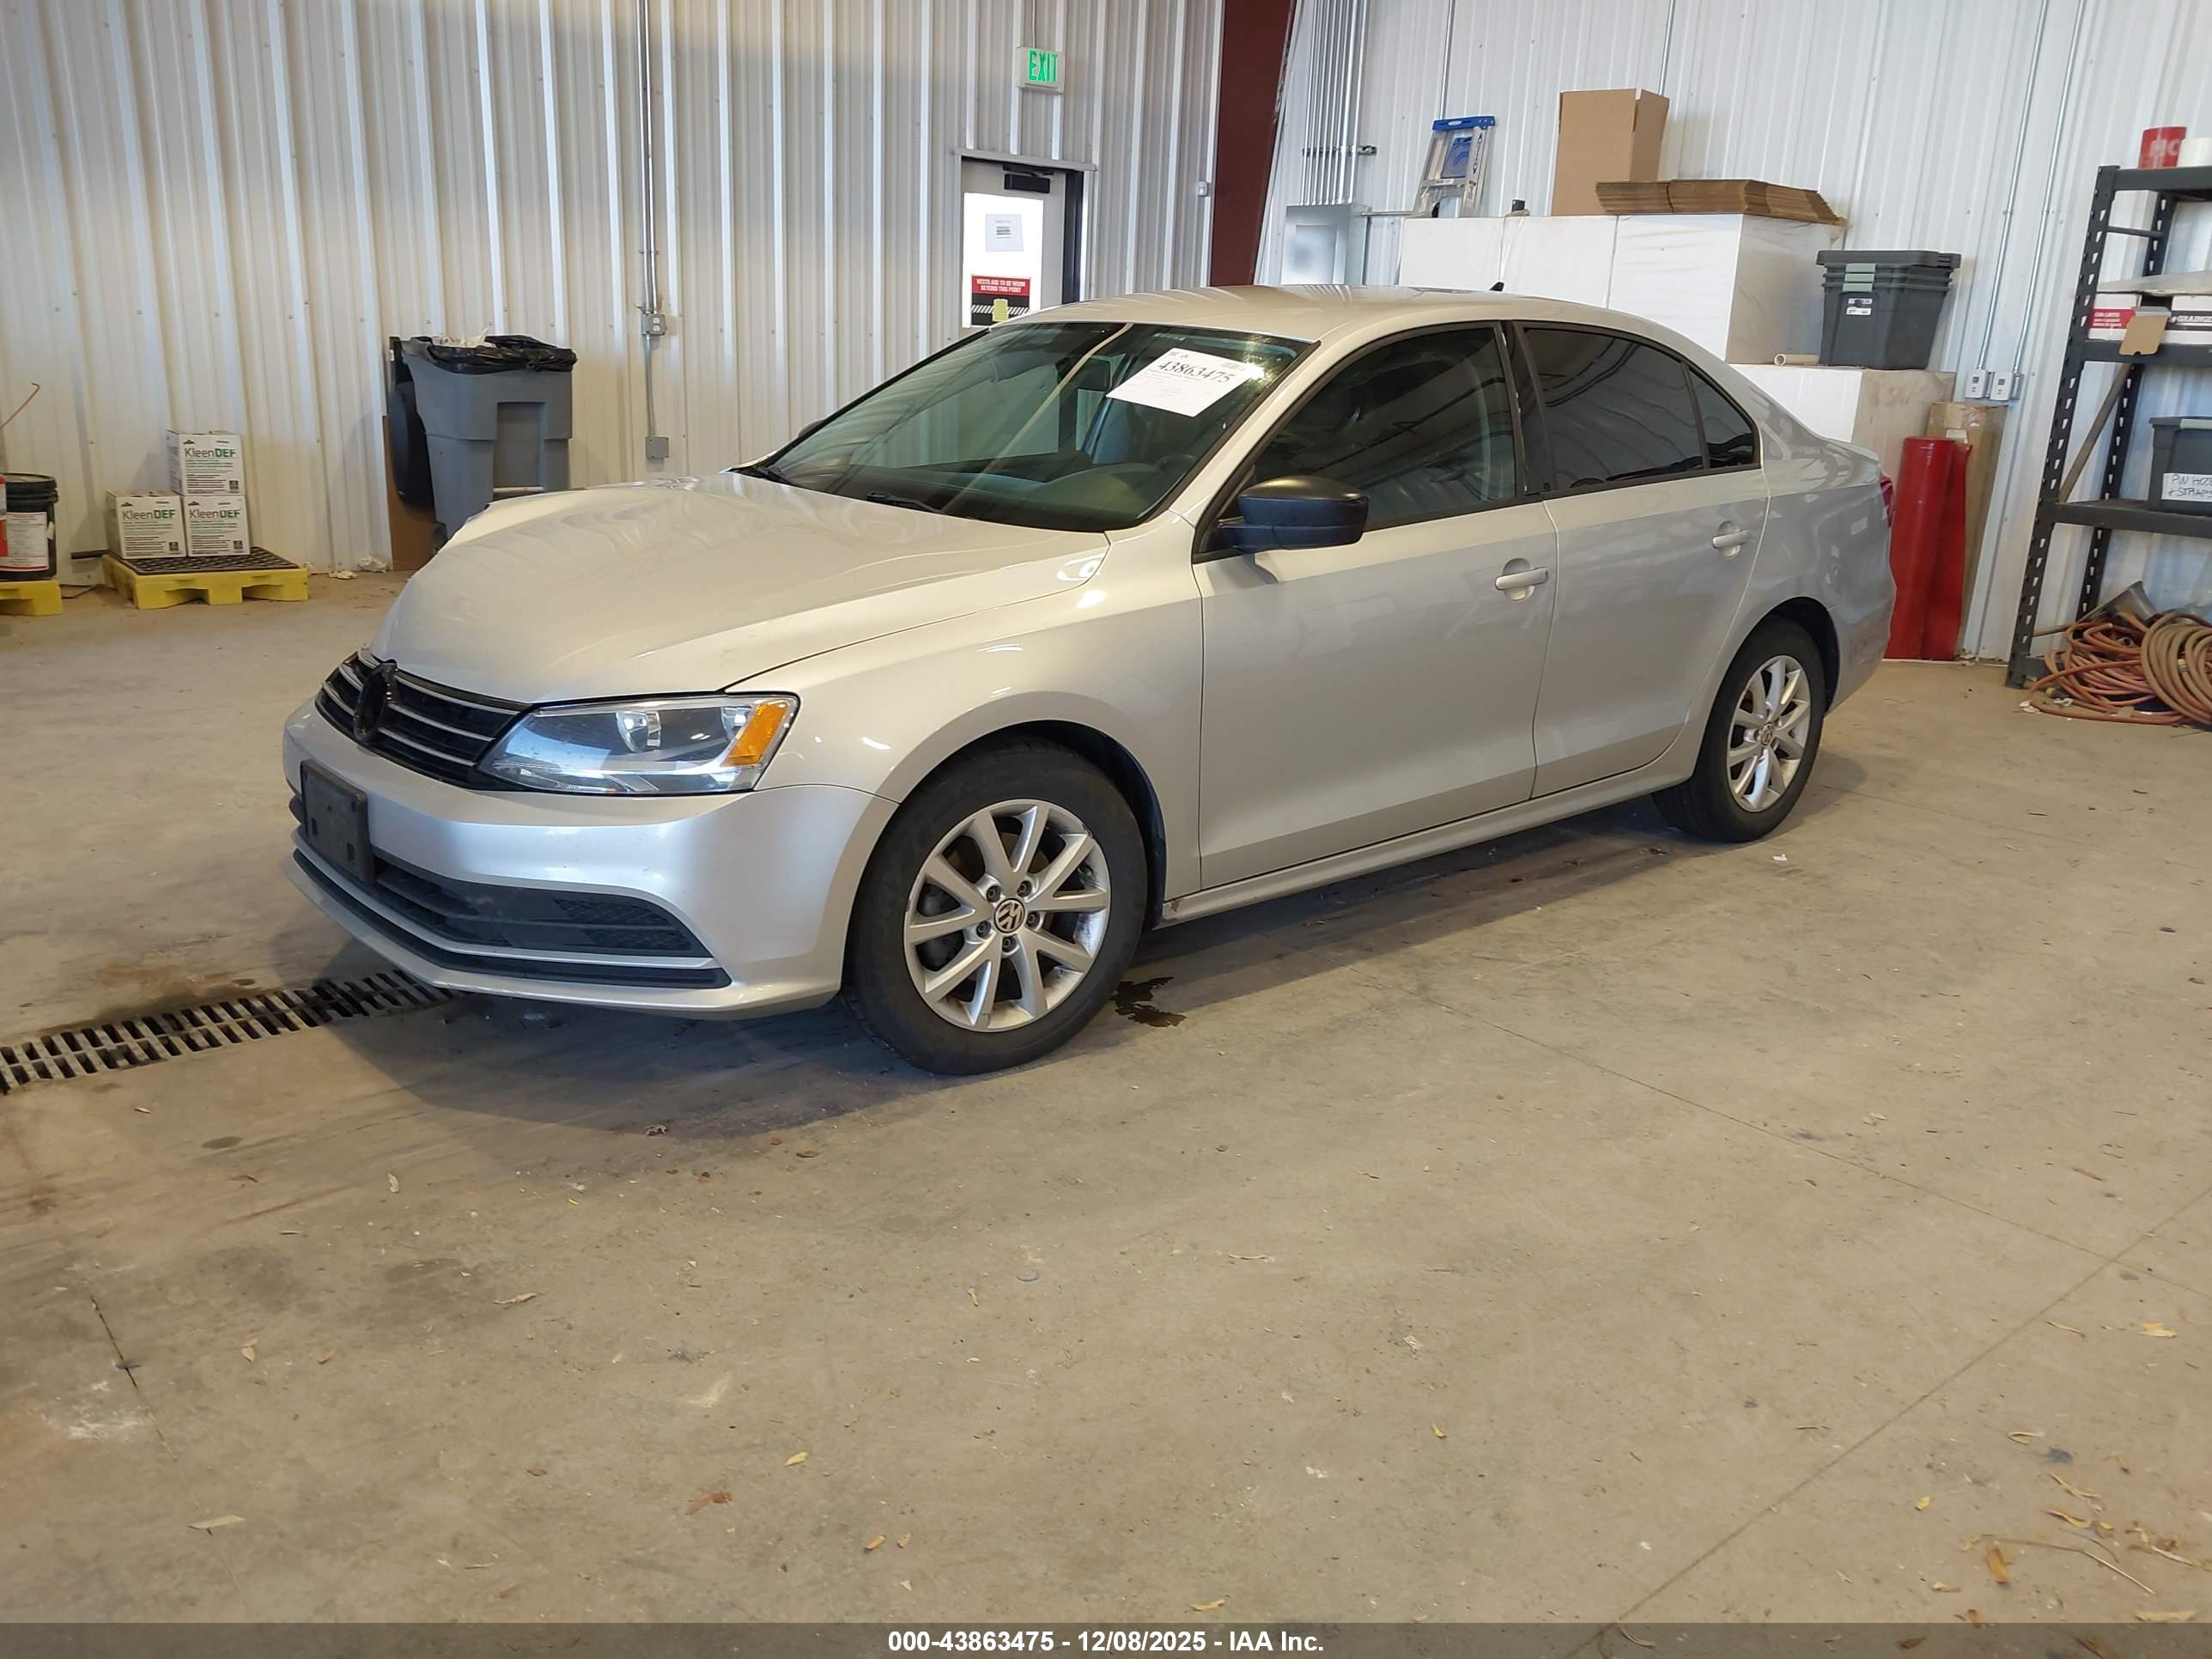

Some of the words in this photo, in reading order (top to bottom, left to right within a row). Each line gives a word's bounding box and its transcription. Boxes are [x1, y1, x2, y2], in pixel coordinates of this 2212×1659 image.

[1029, 50, 1058, 82] EXIT
[1160, 361, 1236, 383] 43863475
[184, 447, 237, 458] KleenDEF
[122, 509, 176, 520] KleenDEF
[189, 508, 241, 519] KleenDEF
